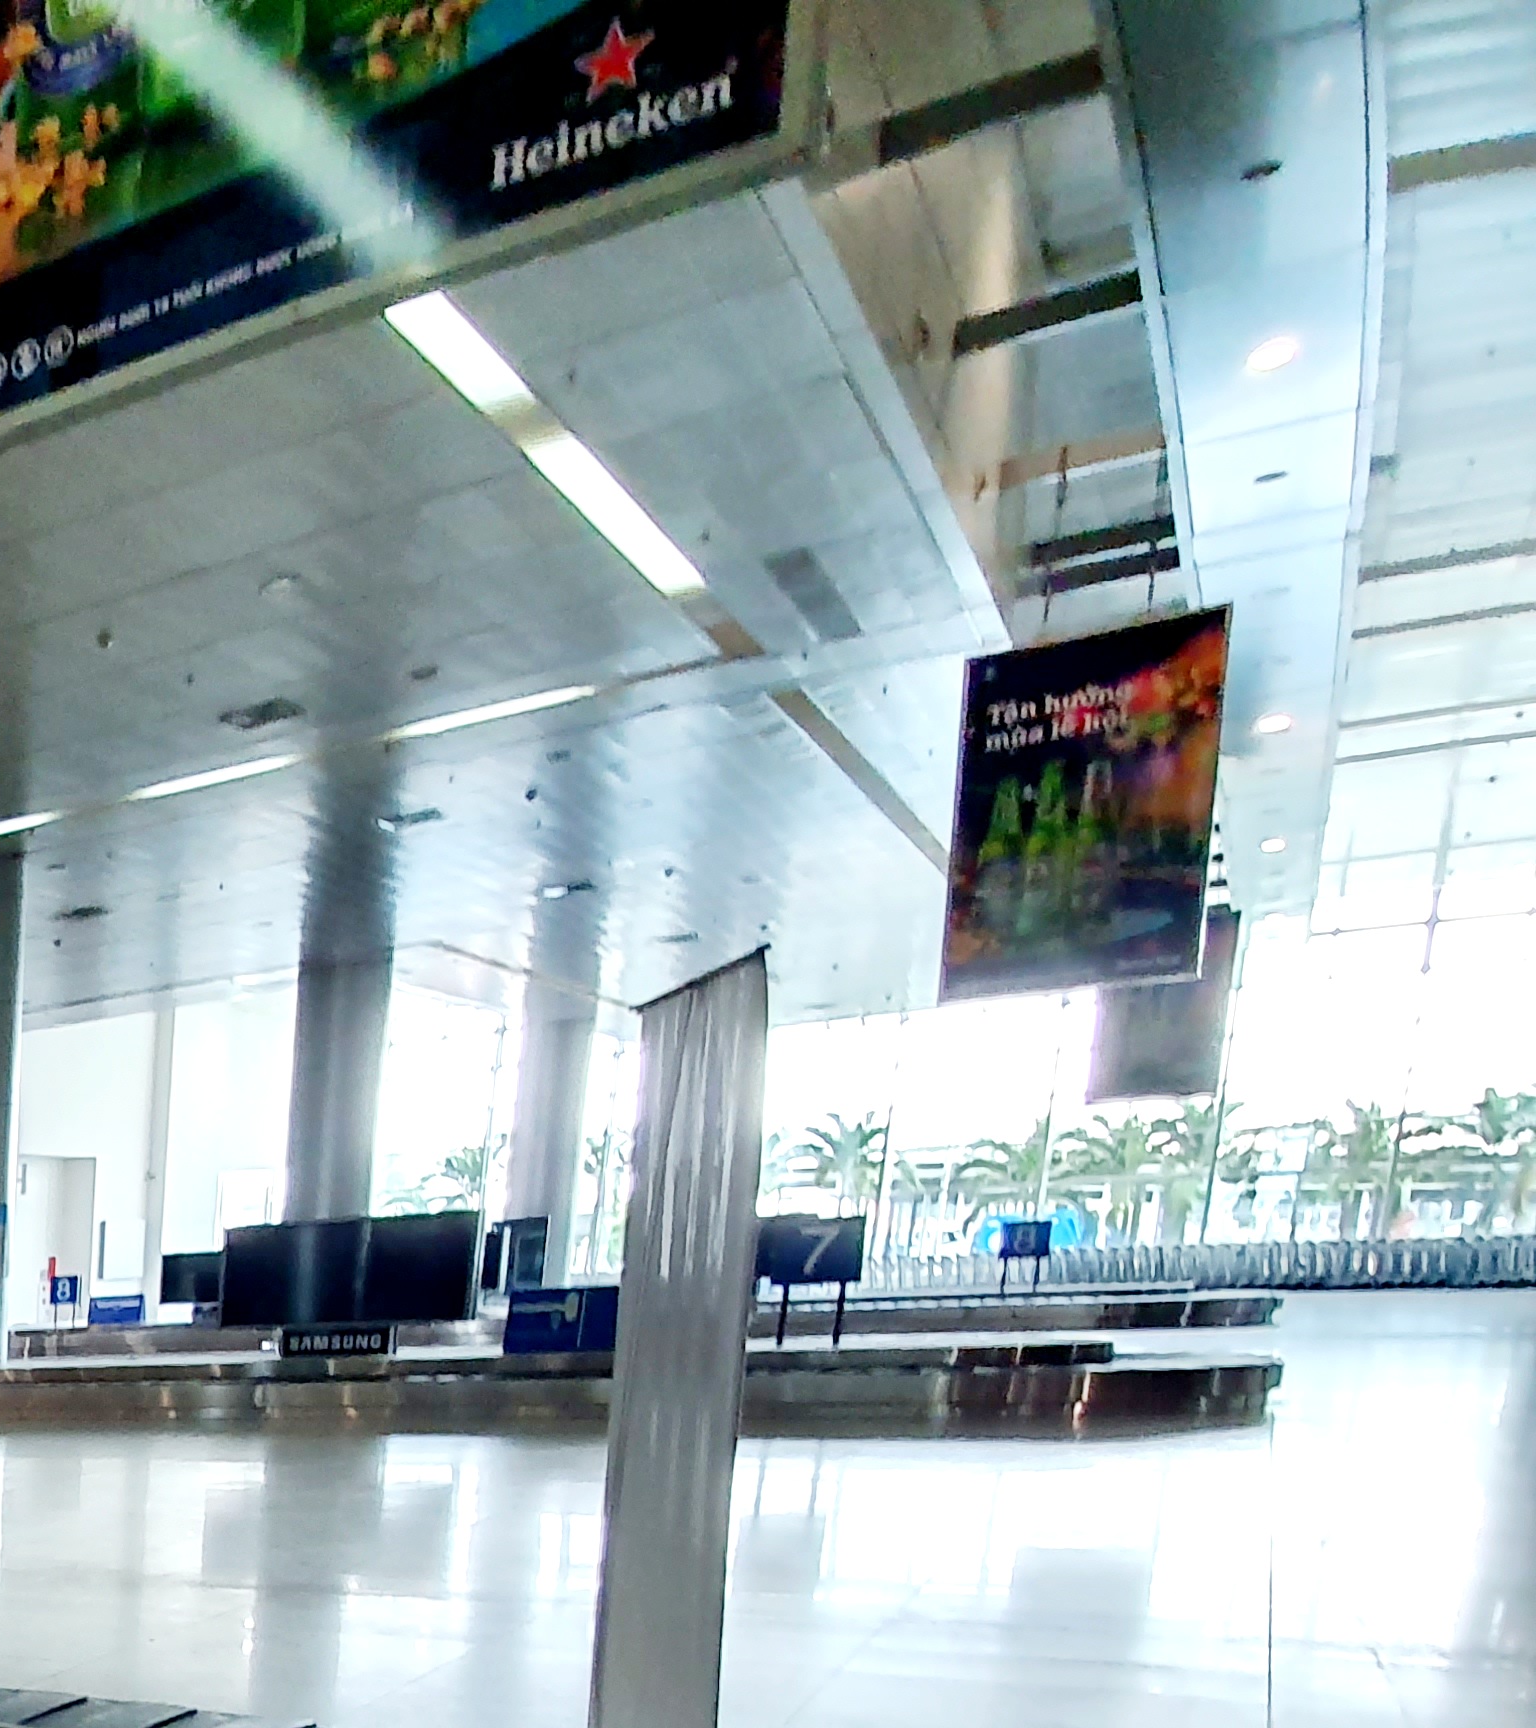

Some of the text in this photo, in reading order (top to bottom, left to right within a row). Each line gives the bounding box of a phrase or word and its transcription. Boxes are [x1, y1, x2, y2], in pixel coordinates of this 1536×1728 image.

[489, 72, 733, 192] Heineken
[799, 1223, 842, 1276] 7
[56, 1278, 71, 1301] 8
[289, 1333, 381, 1352] SAMSUNG
